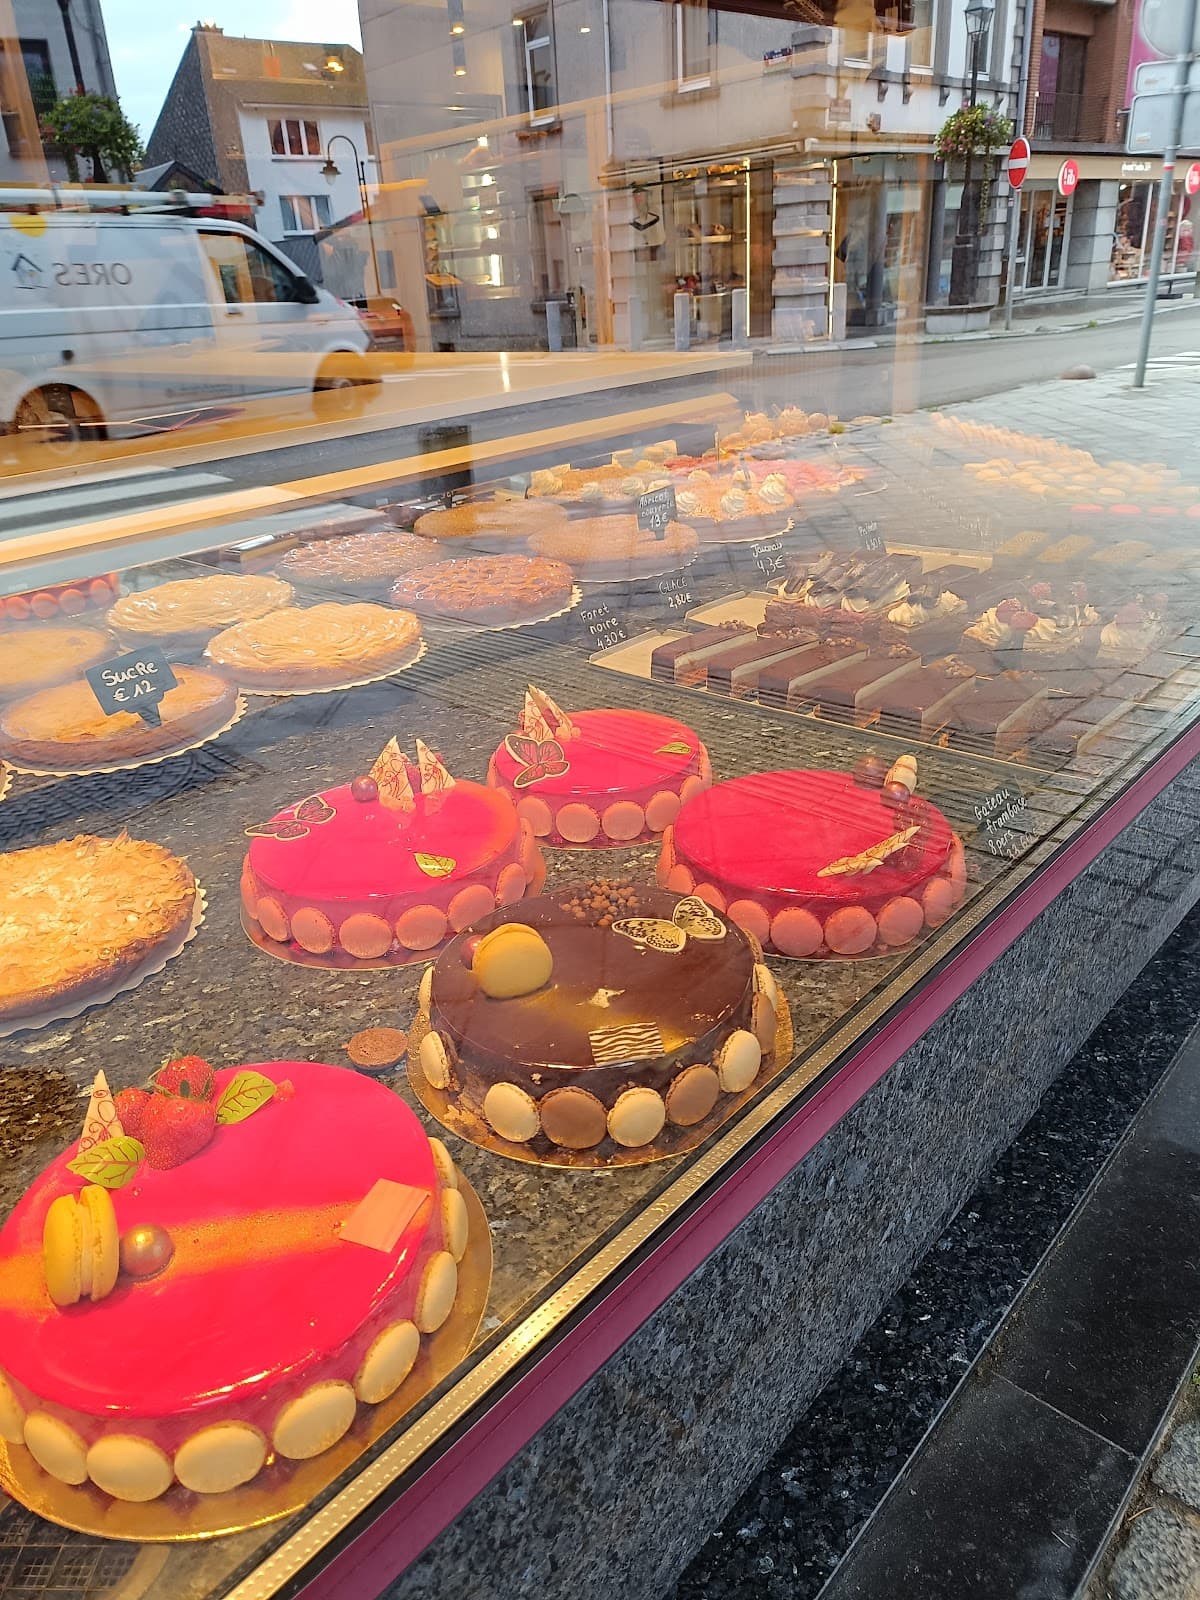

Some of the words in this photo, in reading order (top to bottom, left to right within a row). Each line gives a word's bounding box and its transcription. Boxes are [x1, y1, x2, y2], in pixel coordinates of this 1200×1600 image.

[640, 489, 670, 509] Abricot
[757, 555, 785, 576] 4,3€
[658, 577, 688, 594] GLACE
[668, 592, 693, 609] 2,80€
[580, 602, 610, 623] Foret
[589, 617, 619, 635] noire
[133, 680, 156, 697] 12
[974, 788, 1010, 820] Gateau
[986, 797, 1027, 834] framboise
